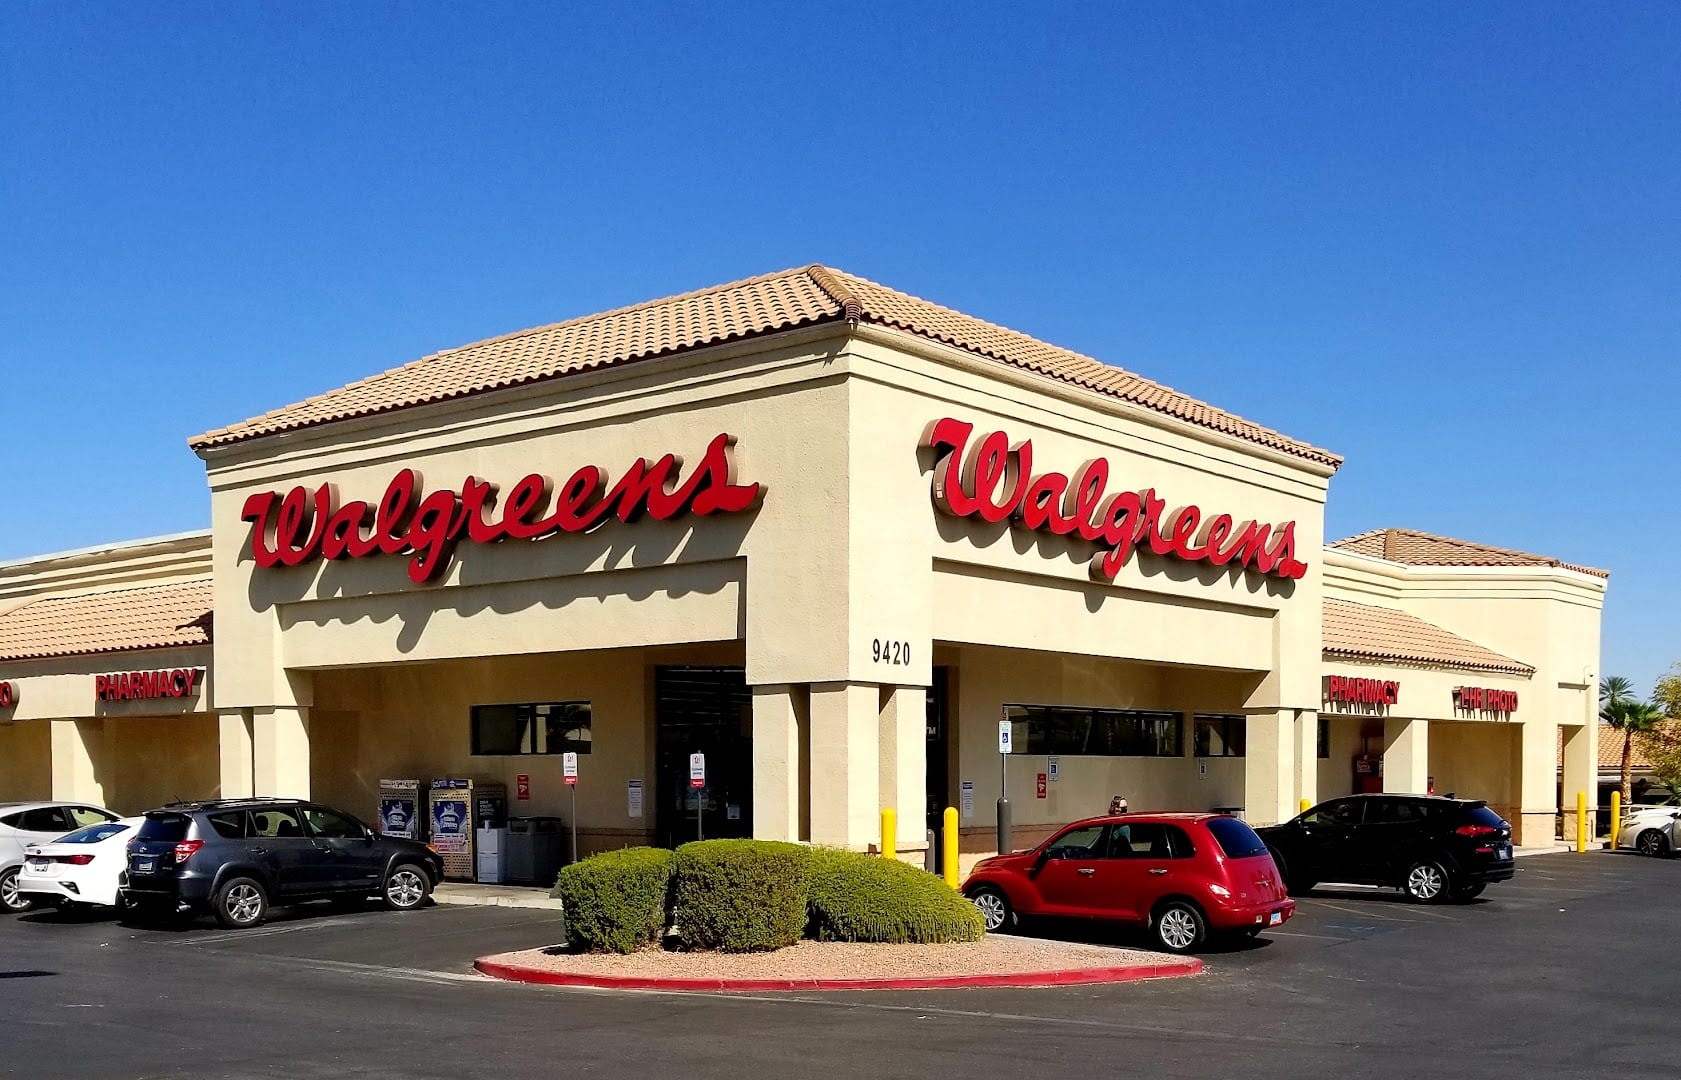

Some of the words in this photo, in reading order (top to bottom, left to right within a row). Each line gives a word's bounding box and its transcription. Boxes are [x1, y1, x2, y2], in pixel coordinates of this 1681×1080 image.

[241, 433, 759, 584] Walgreens
[930, 417, 1308, 579] Walgreens
[873, 638, 910, 666] 9420
[95, 669, 197, 701] PHARMACY
[1329, 675, 1400, 705] PHARMACY
[1459, 686, 1483, 709] 1-HR
[1486, 689, 1518, 712] PHOTO
